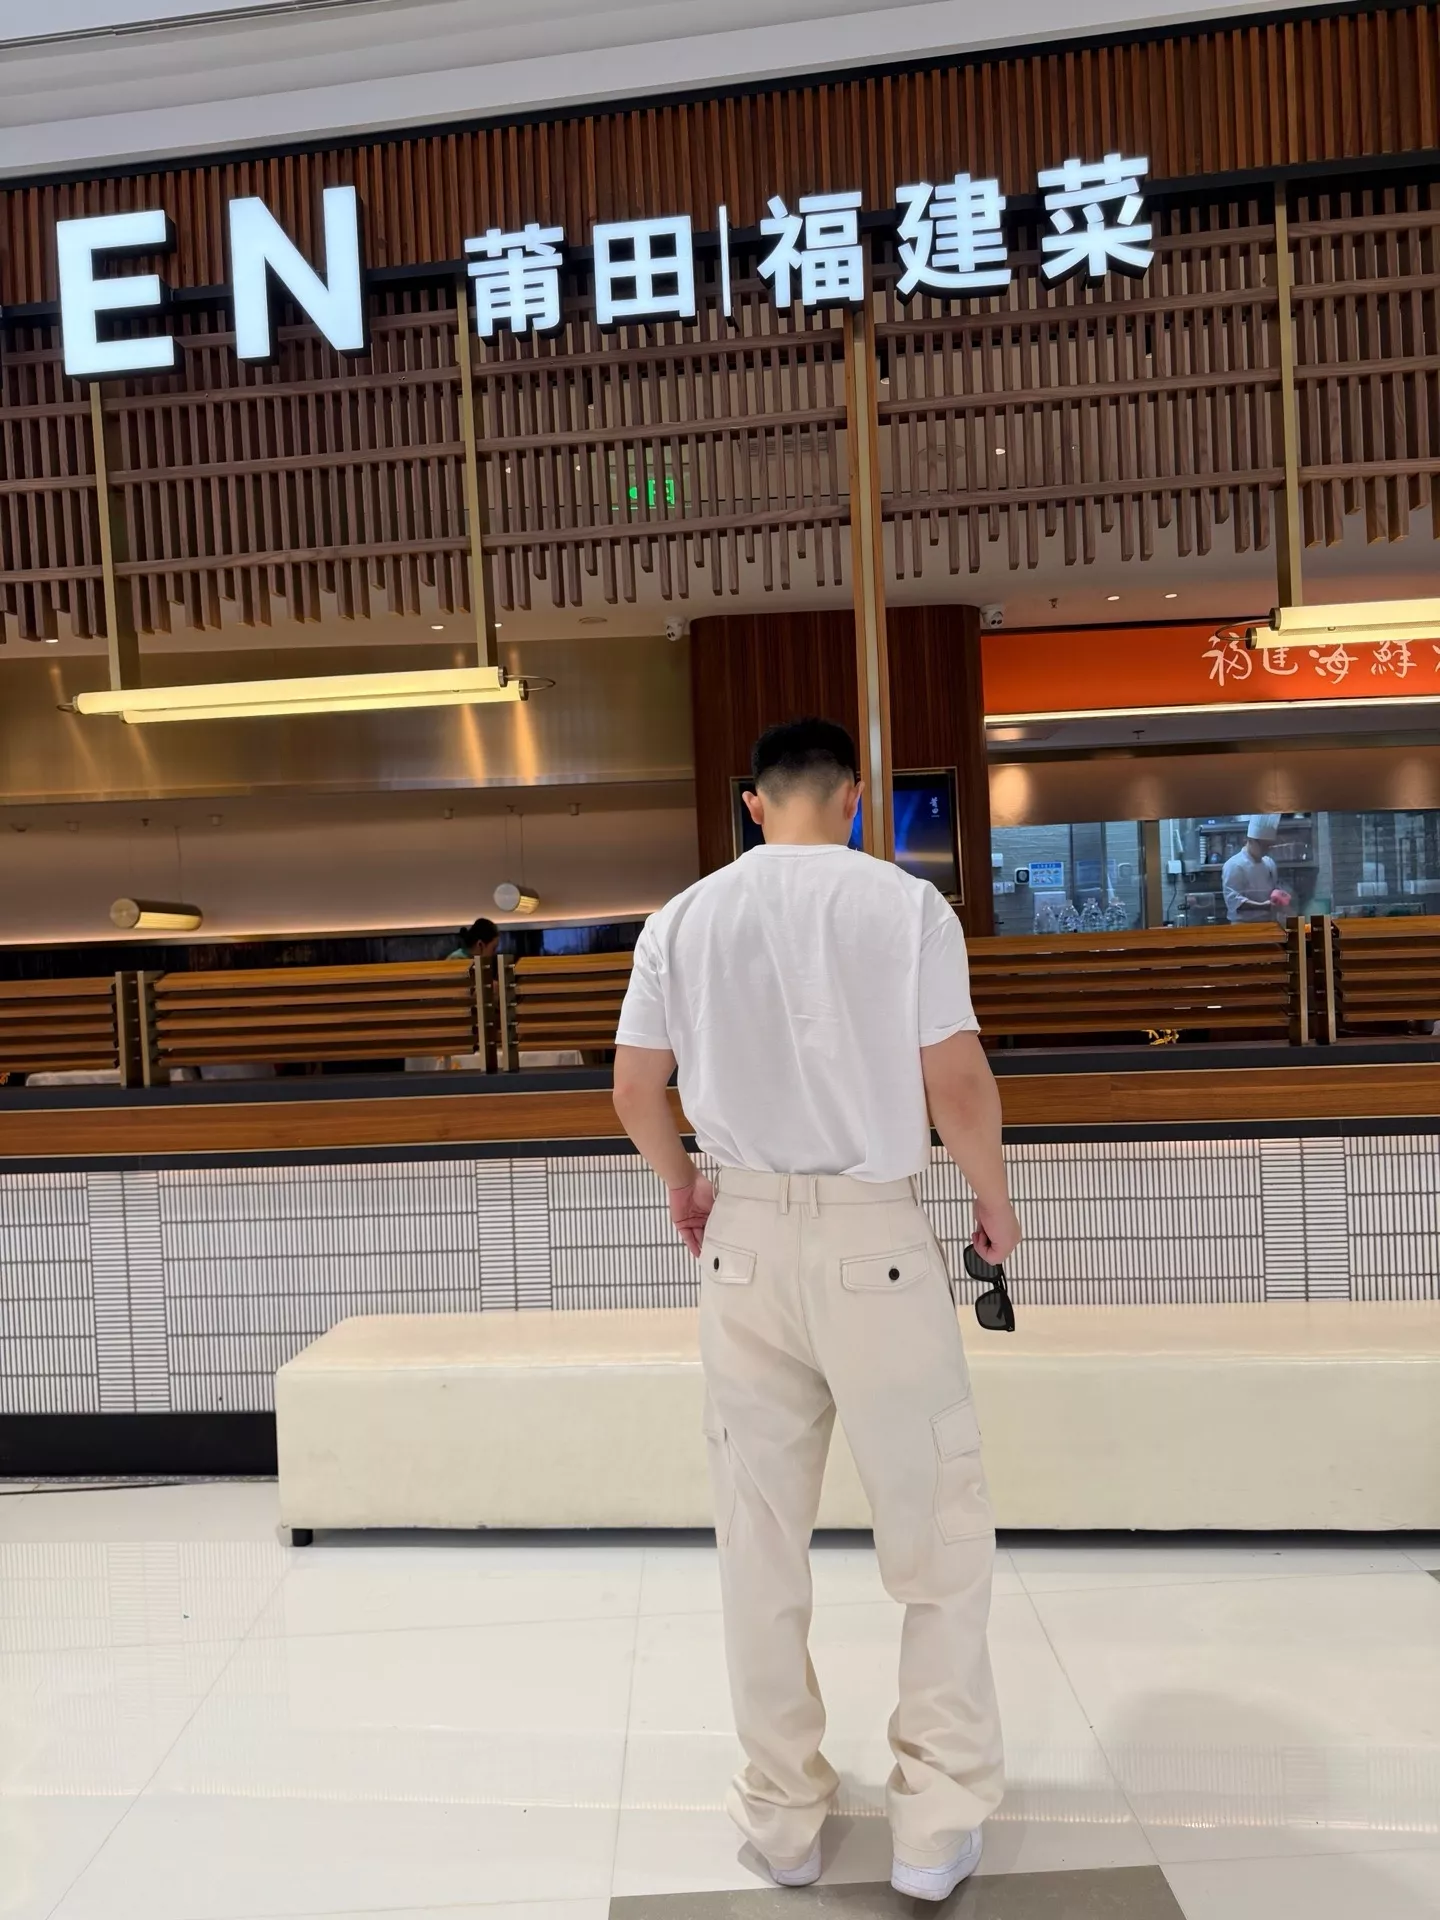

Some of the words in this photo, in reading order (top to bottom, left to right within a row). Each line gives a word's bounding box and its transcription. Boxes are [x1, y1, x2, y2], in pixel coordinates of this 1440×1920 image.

[56, 185, 364, 376] EN
[465, 215, 697, 338] 莆田
[757, 153, 1155, 309] 福建菜
